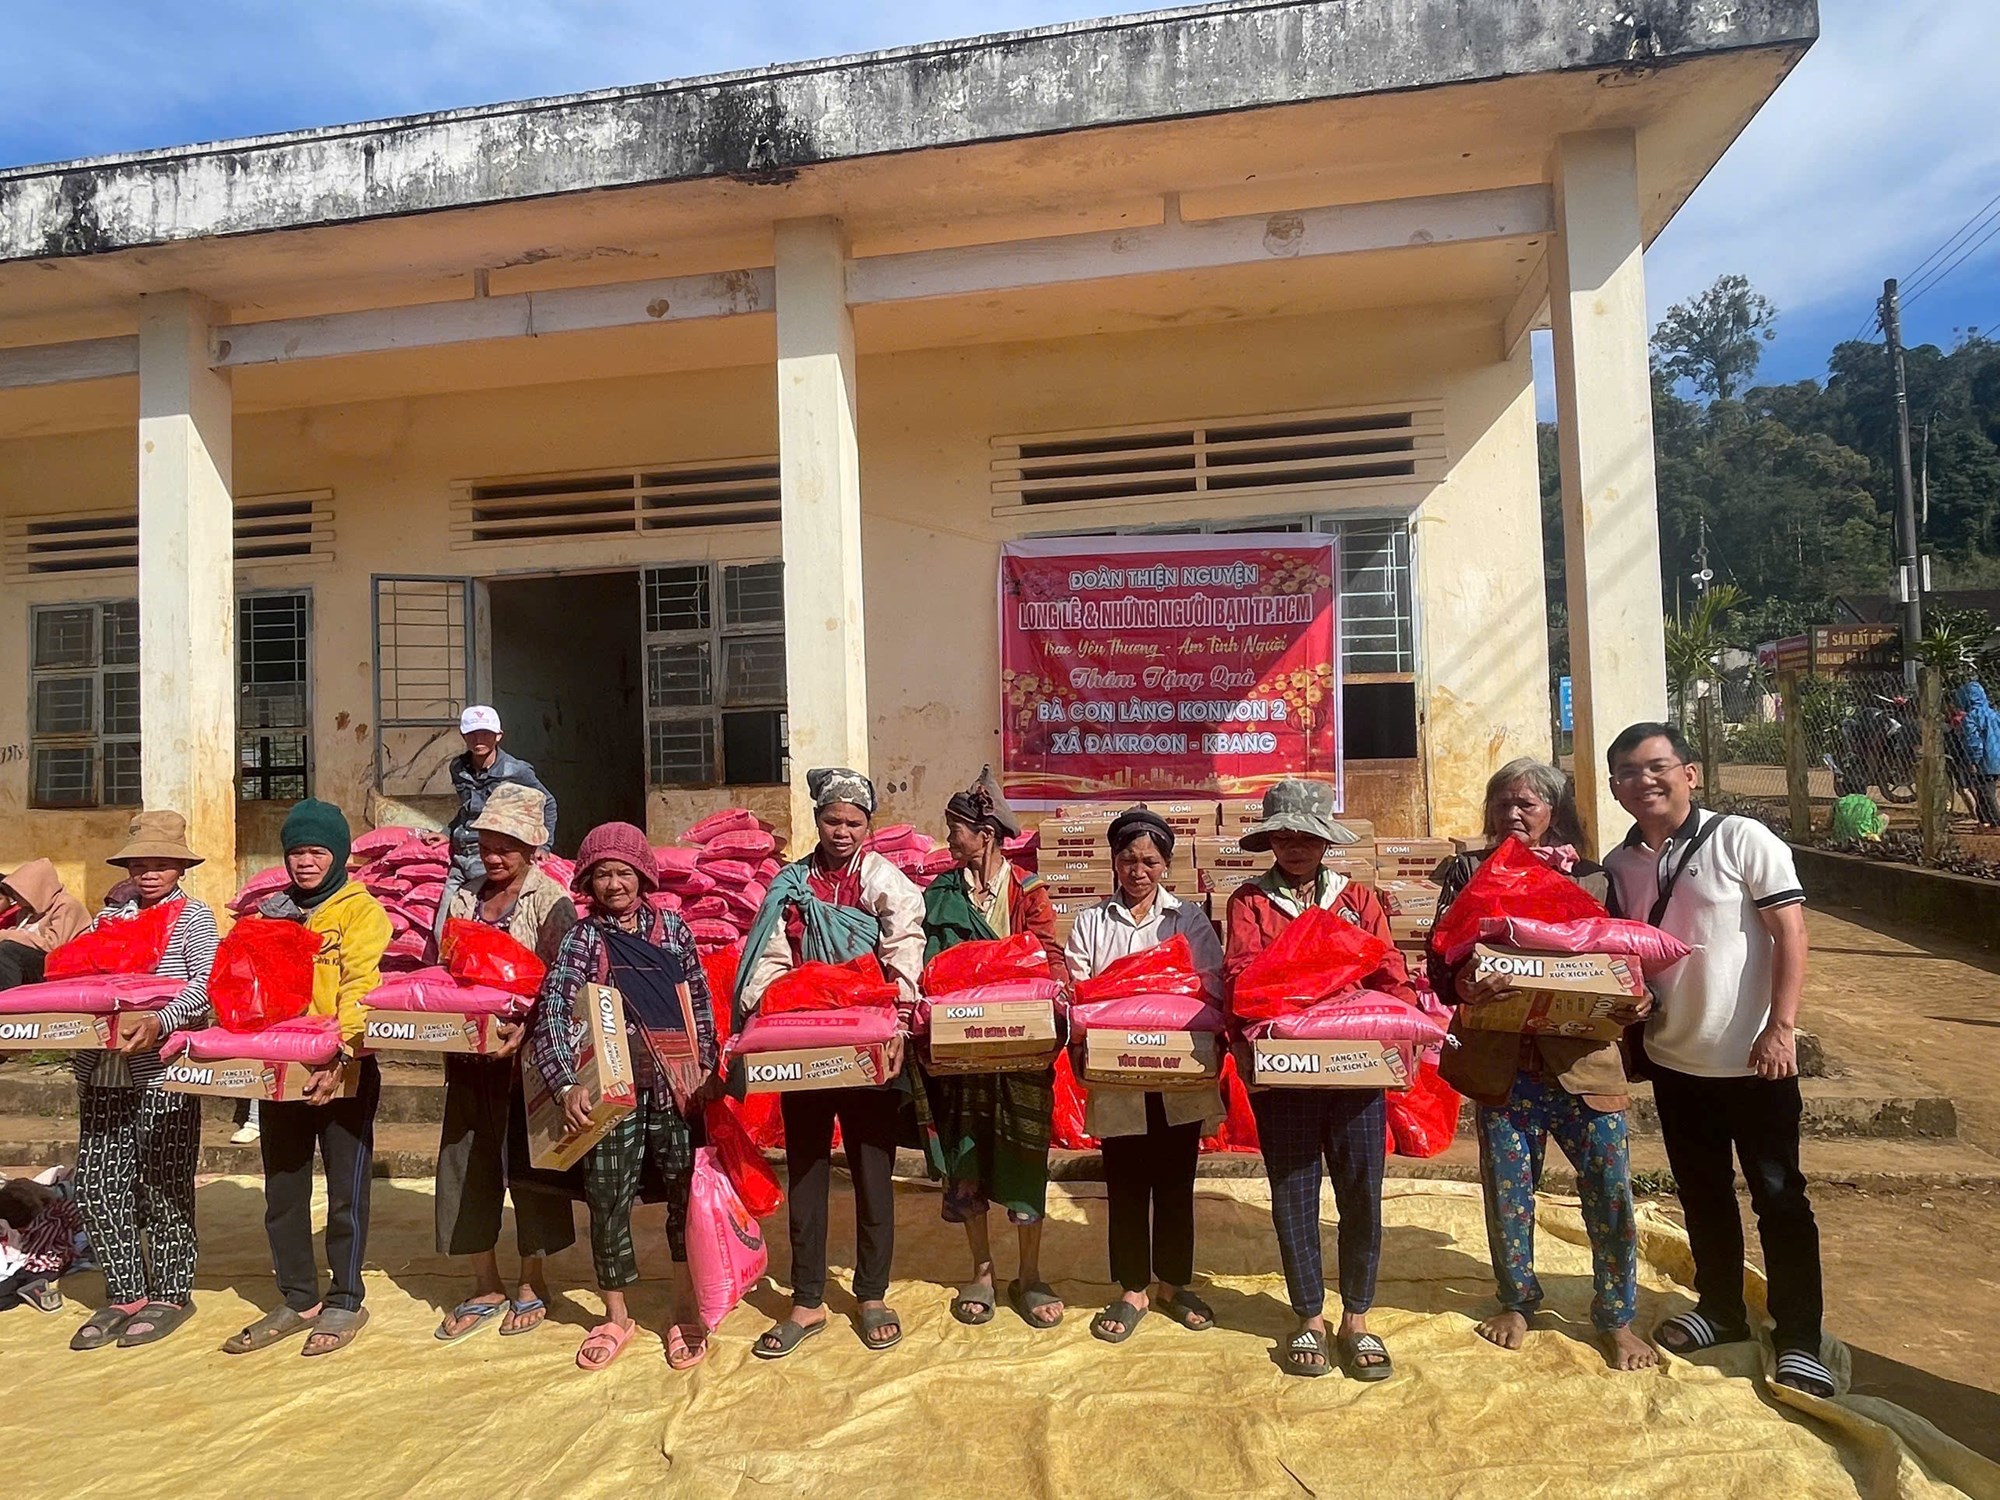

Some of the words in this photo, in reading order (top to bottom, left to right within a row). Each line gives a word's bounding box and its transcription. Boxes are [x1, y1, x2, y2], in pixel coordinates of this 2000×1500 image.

[1069, 565, 1124, 590] ĐOÀN
[1127, 563, 1178, 592] THIỆN
[1182, 561, 1259, 589] NGUYỆN
[1019, 602, 1059, 630] LONG
[1061, 597, 1081, 629] LÊ
[1084, 602, 1098, 629] &
[1100, 596, 1158, 629] NHỮNG
[1160, 592, 1212, 627] NGƯỜI
[1213, 598, 1250, 631] BẠN
[1252, 594, 1313, 625] TP.HCM
[1041, 640, 1072, 656] Trao
[1078, 640, 1105, 658] Yêu
[1107, 638, 1164, 659] Thương
[1207, 635, 1239, 654] Tình
[1244, 634, 1287, 659] Người
[1069, 667, 1136, 689] Thăm
[1143, 666, 1204, 692] Tặng
[1210, 665, 1256, 691] Quà
[1038, 697, 1066, 722] BÀ
[1068, 701, 1115, 722] CON
[1118, 696, 1175, 722] LÀNG
[1178, 699, 1268, 722] KONVON
[1271, 699, 1287, 721] 2
[1051, 726, 1082, 754] XÃ
[1085, 733, 1187, 754] ĐAKROON
[1189, 741, 1199, 750] -
[1202, 732, 1277, 754] KBANG
[1169, 805, 1192, 813] KOMI
[1480, 956, 1544, 978] KOMI
[598, 988, 616, 1035] KOMI
[947, 1006, 984, 1018] KOMI
[0, 1023, 40, 1039] OMI
[367, 1022, 416, 1040] KOMI
[1127, 1033, 1167, 1046] KOMI
[1257, 1053, 1320, 1073] KOMI
[1359, 1051, 1368, 1059] LY
[166, 1065, 214, 1085] KOMI
[748, 1063, 802, 1082] KOMI
